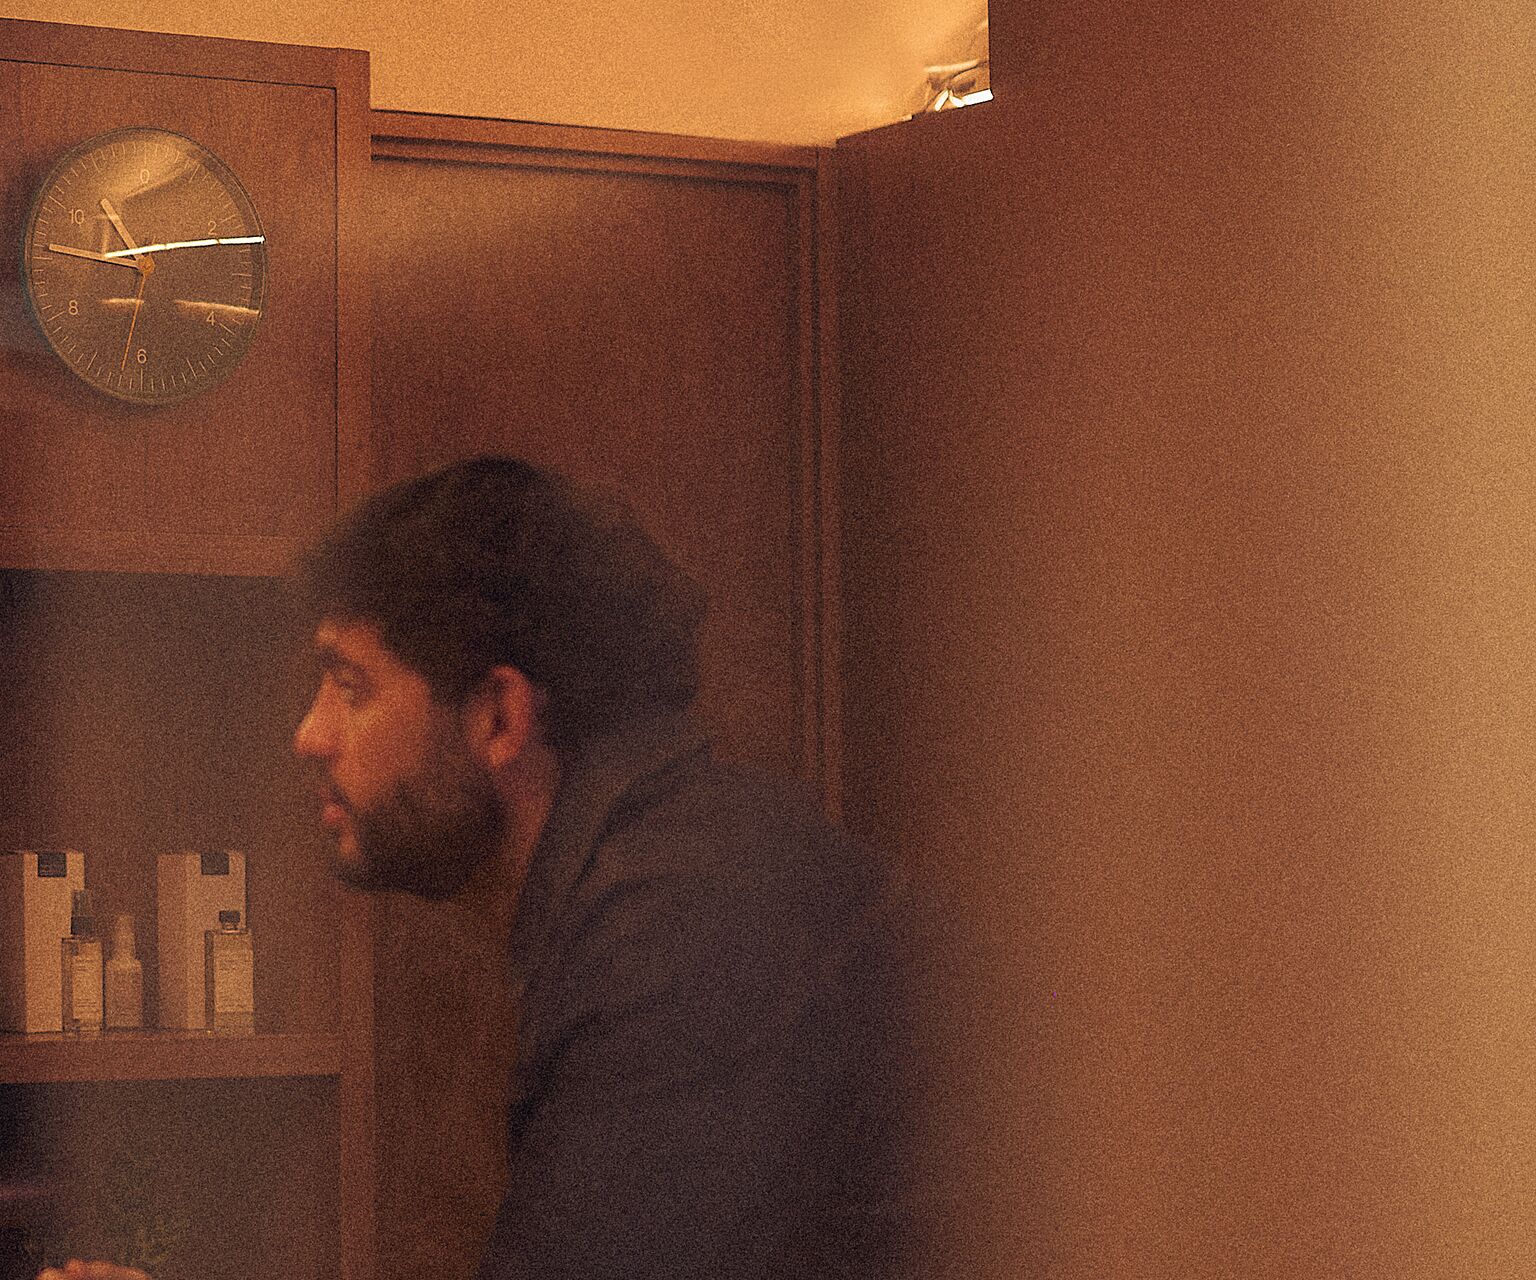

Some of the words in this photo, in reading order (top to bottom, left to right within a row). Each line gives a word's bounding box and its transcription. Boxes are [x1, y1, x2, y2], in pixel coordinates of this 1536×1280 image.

[68, 208, 86, 224] 10
[207, 221, 218, 235] 2
[67, 300, 79, 315] 8
[205, 311, 216, 326] 4
[136, 348, 148, 364] 6
